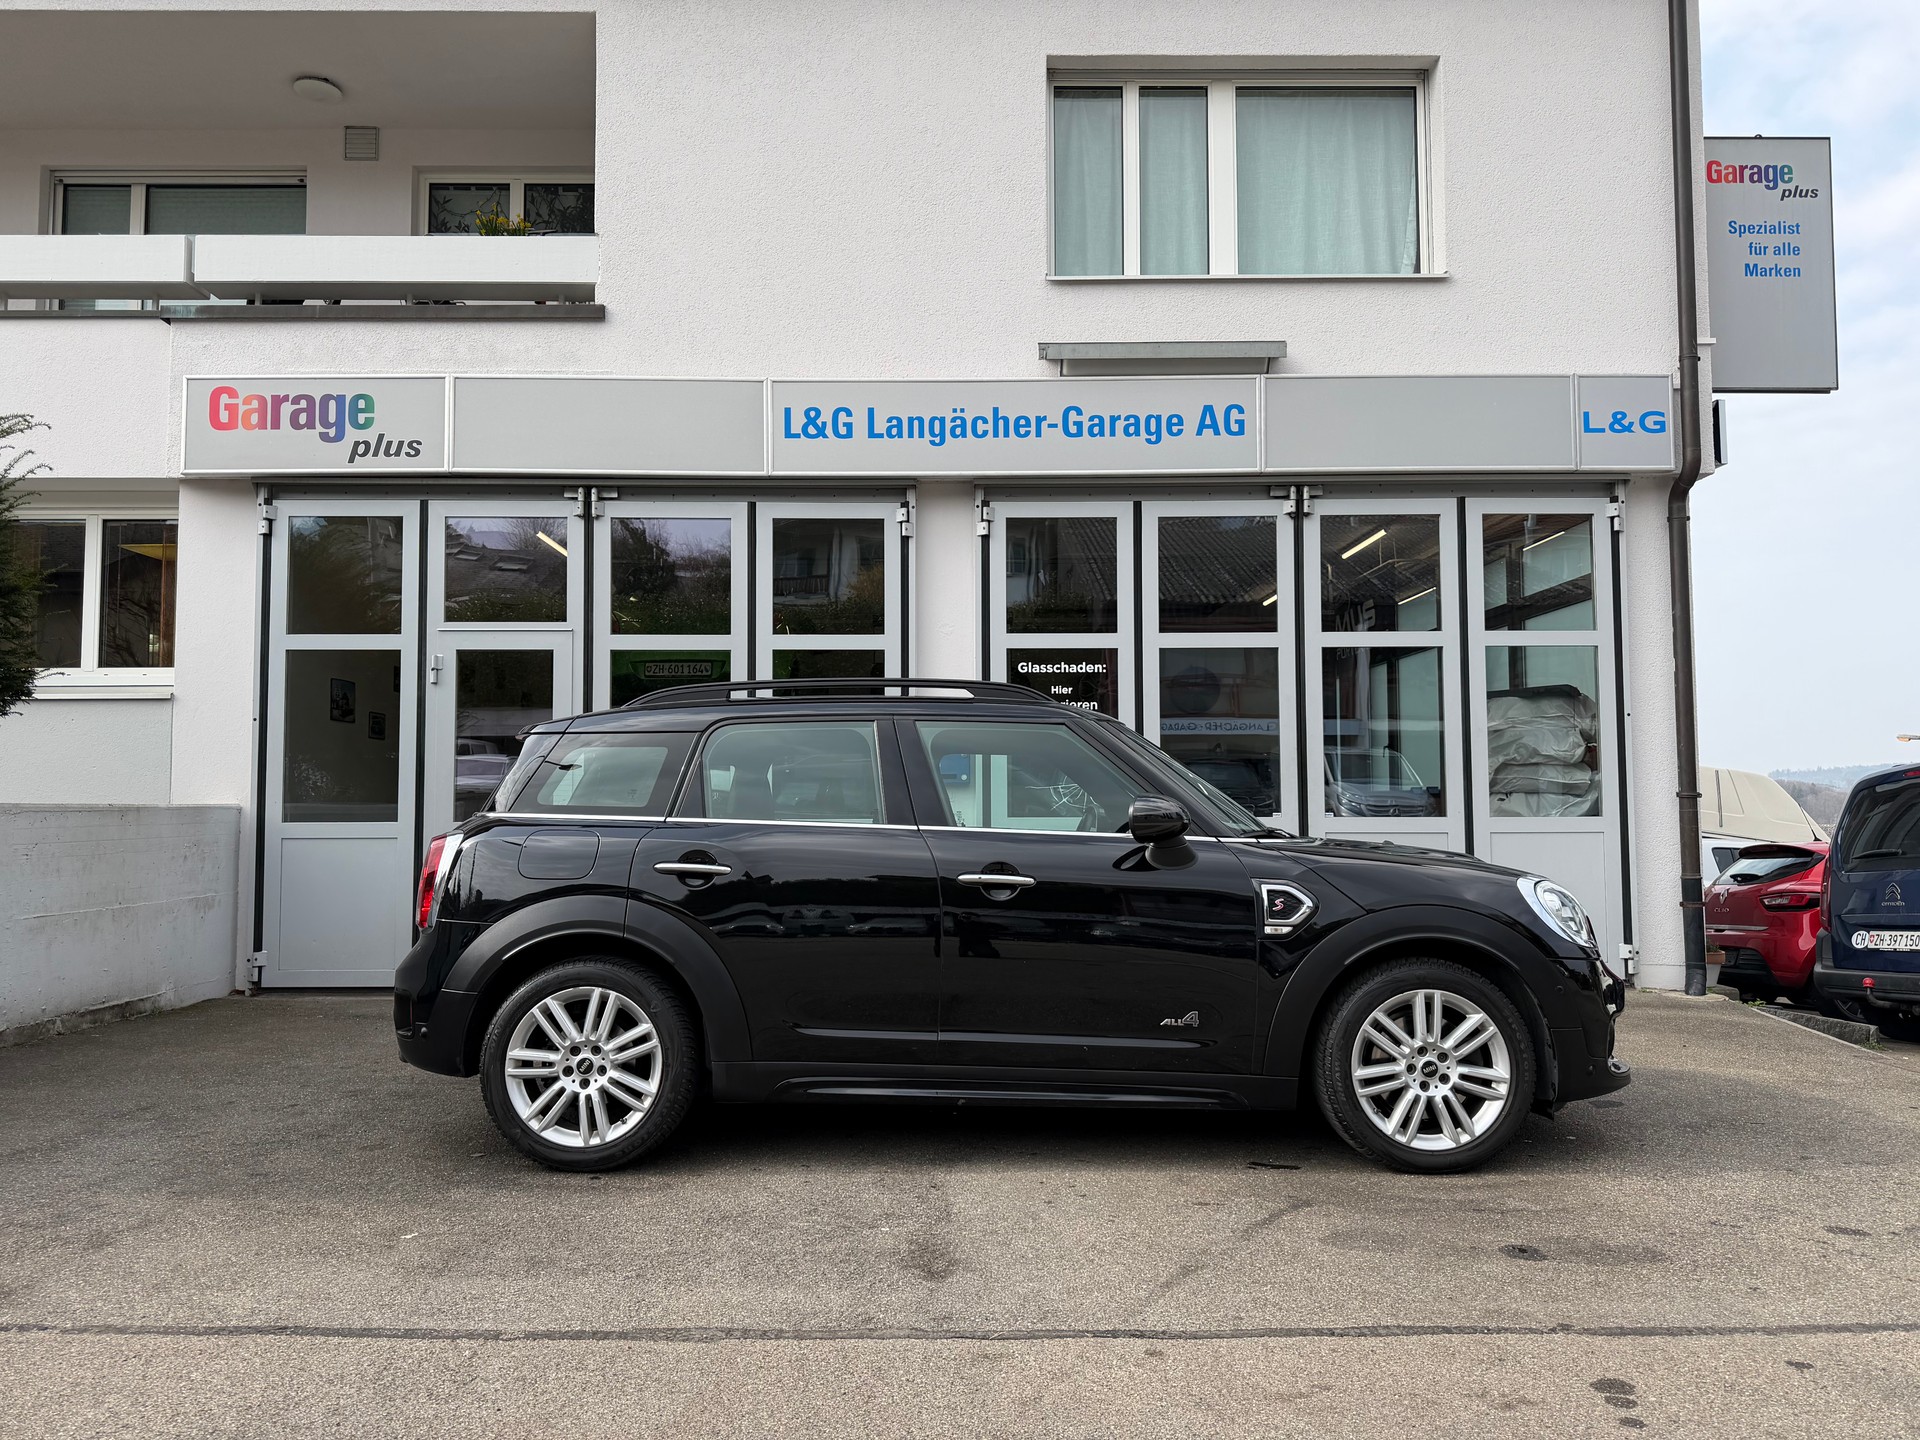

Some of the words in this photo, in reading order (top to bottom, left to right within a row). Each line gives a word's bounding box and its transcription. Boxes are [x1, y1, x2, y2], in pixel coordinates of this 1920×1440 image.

[1706, 160, 1794, 190] Garage
[1780, 184, 1819, 202] plus
[1728, 220, 1801, 238] Spezialist
[1748, 242, 1769, 256] für
[1773, 242, 1801, 256] alle
[1744, 263, 1801, 278] Marken
[208, 385, 376, 444] Garage
[1582, 410, 1667, 434] L&G
[783, 406, 854, 440] L&G
[867, 405, 1185, 447] Langächer-Garage
[1195, 403, 1247, 437] AG
[347, 433, 423, 464] plus
[1017, 661, 1107, 673] Glasschaden:
[1050, 685, 1073, 694] Hier
[1272, 898, 1285, 911] S
[1855, 932, 1867, 946] CH
[1160, 1010, 1200, 1028] ALL4
